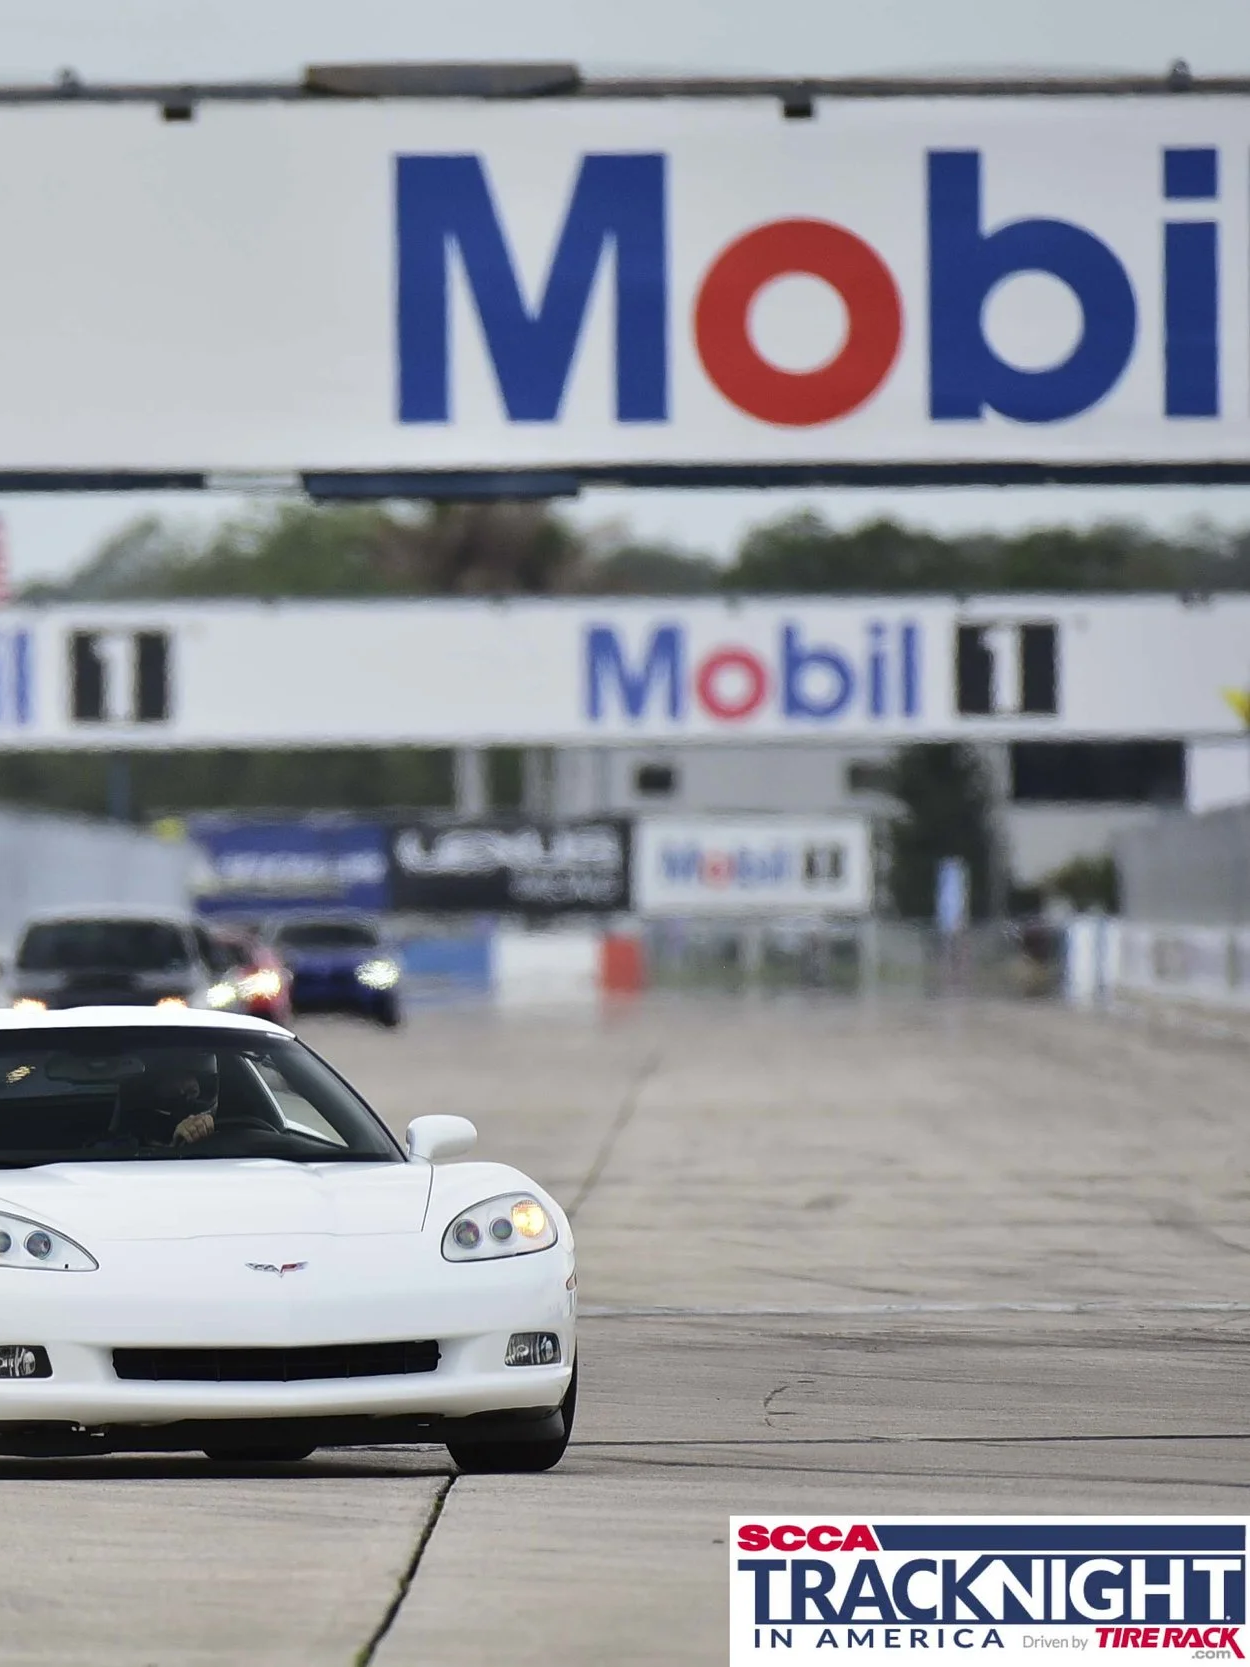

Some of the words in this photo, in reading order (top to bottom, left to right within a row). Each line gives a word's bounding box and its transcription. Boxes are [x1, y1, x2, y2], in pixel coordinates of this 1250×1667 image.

[92, 632, 137, 722] 1
[584, 620, 920, 722] Mobil
[977, 626, 1026, 714] 1
